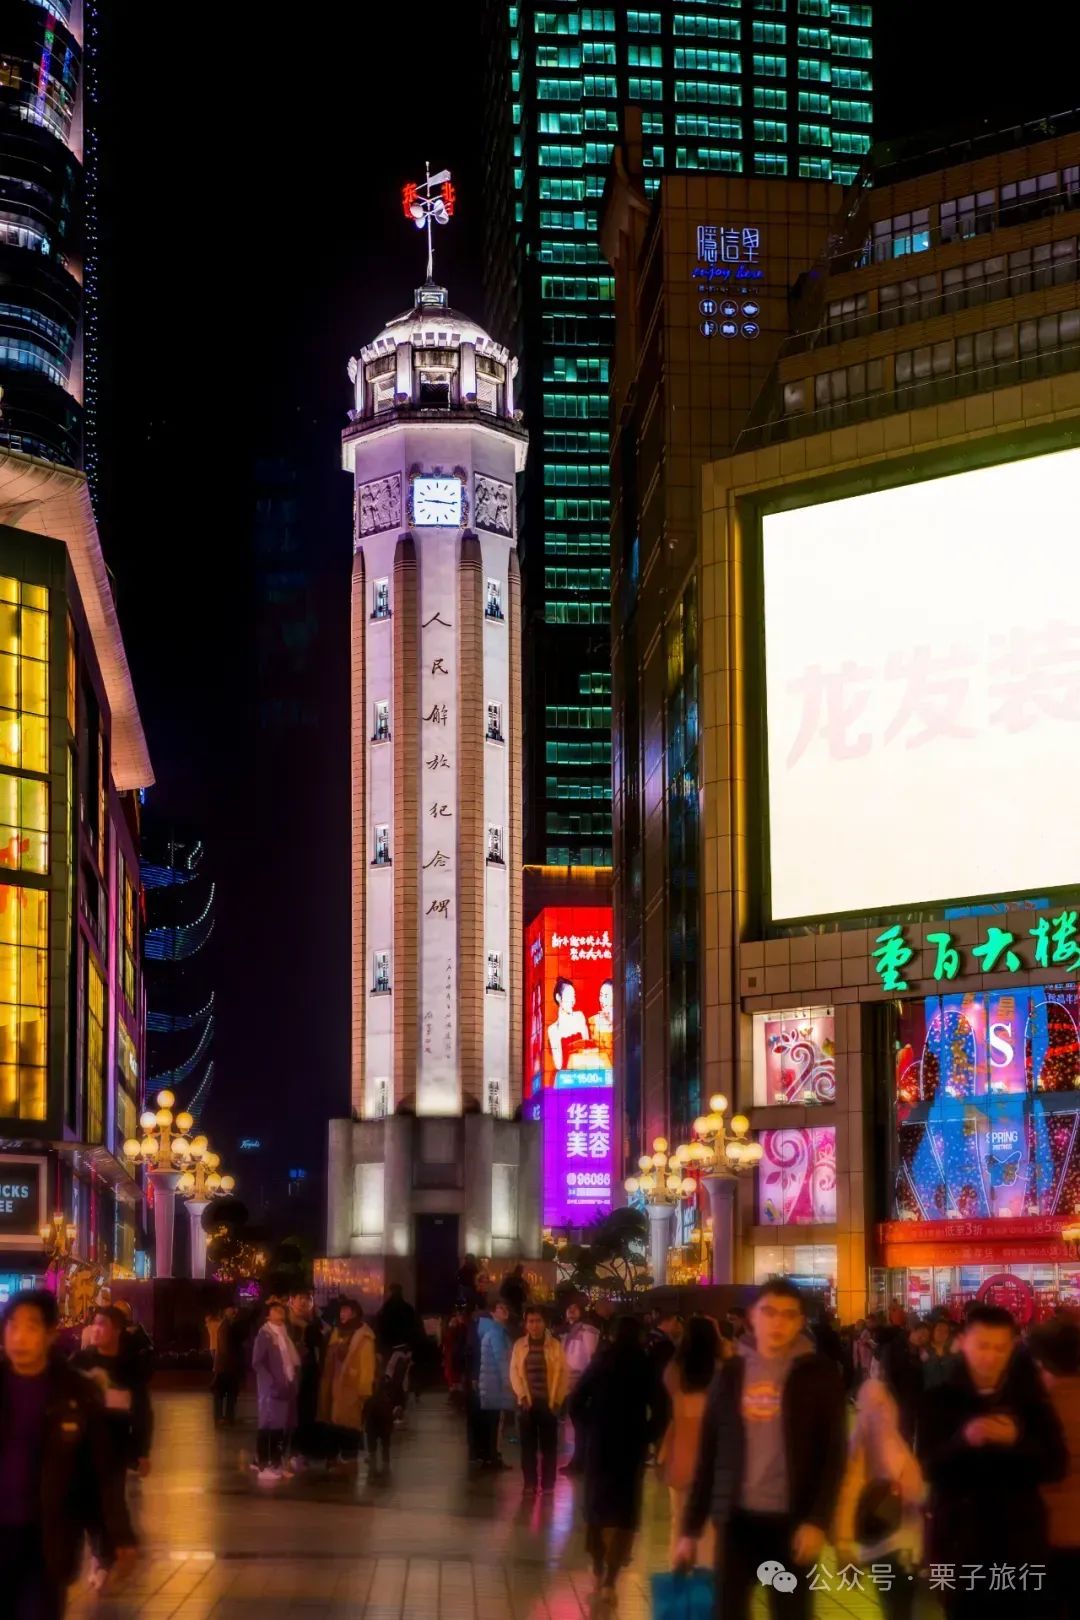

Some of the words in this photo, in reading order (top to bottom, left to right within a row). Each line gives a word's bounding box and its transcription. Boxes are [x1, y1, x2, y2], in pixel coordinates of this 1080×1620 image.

[872, 911, 1080, 991] 重百大楼
[567, 1103, 609, 1130] 华美
[567, 1131, 609, 1158] 美容
[986, 1131, 1018, 1143] SPRING
[0, 1185, 29, 1198] CKS
